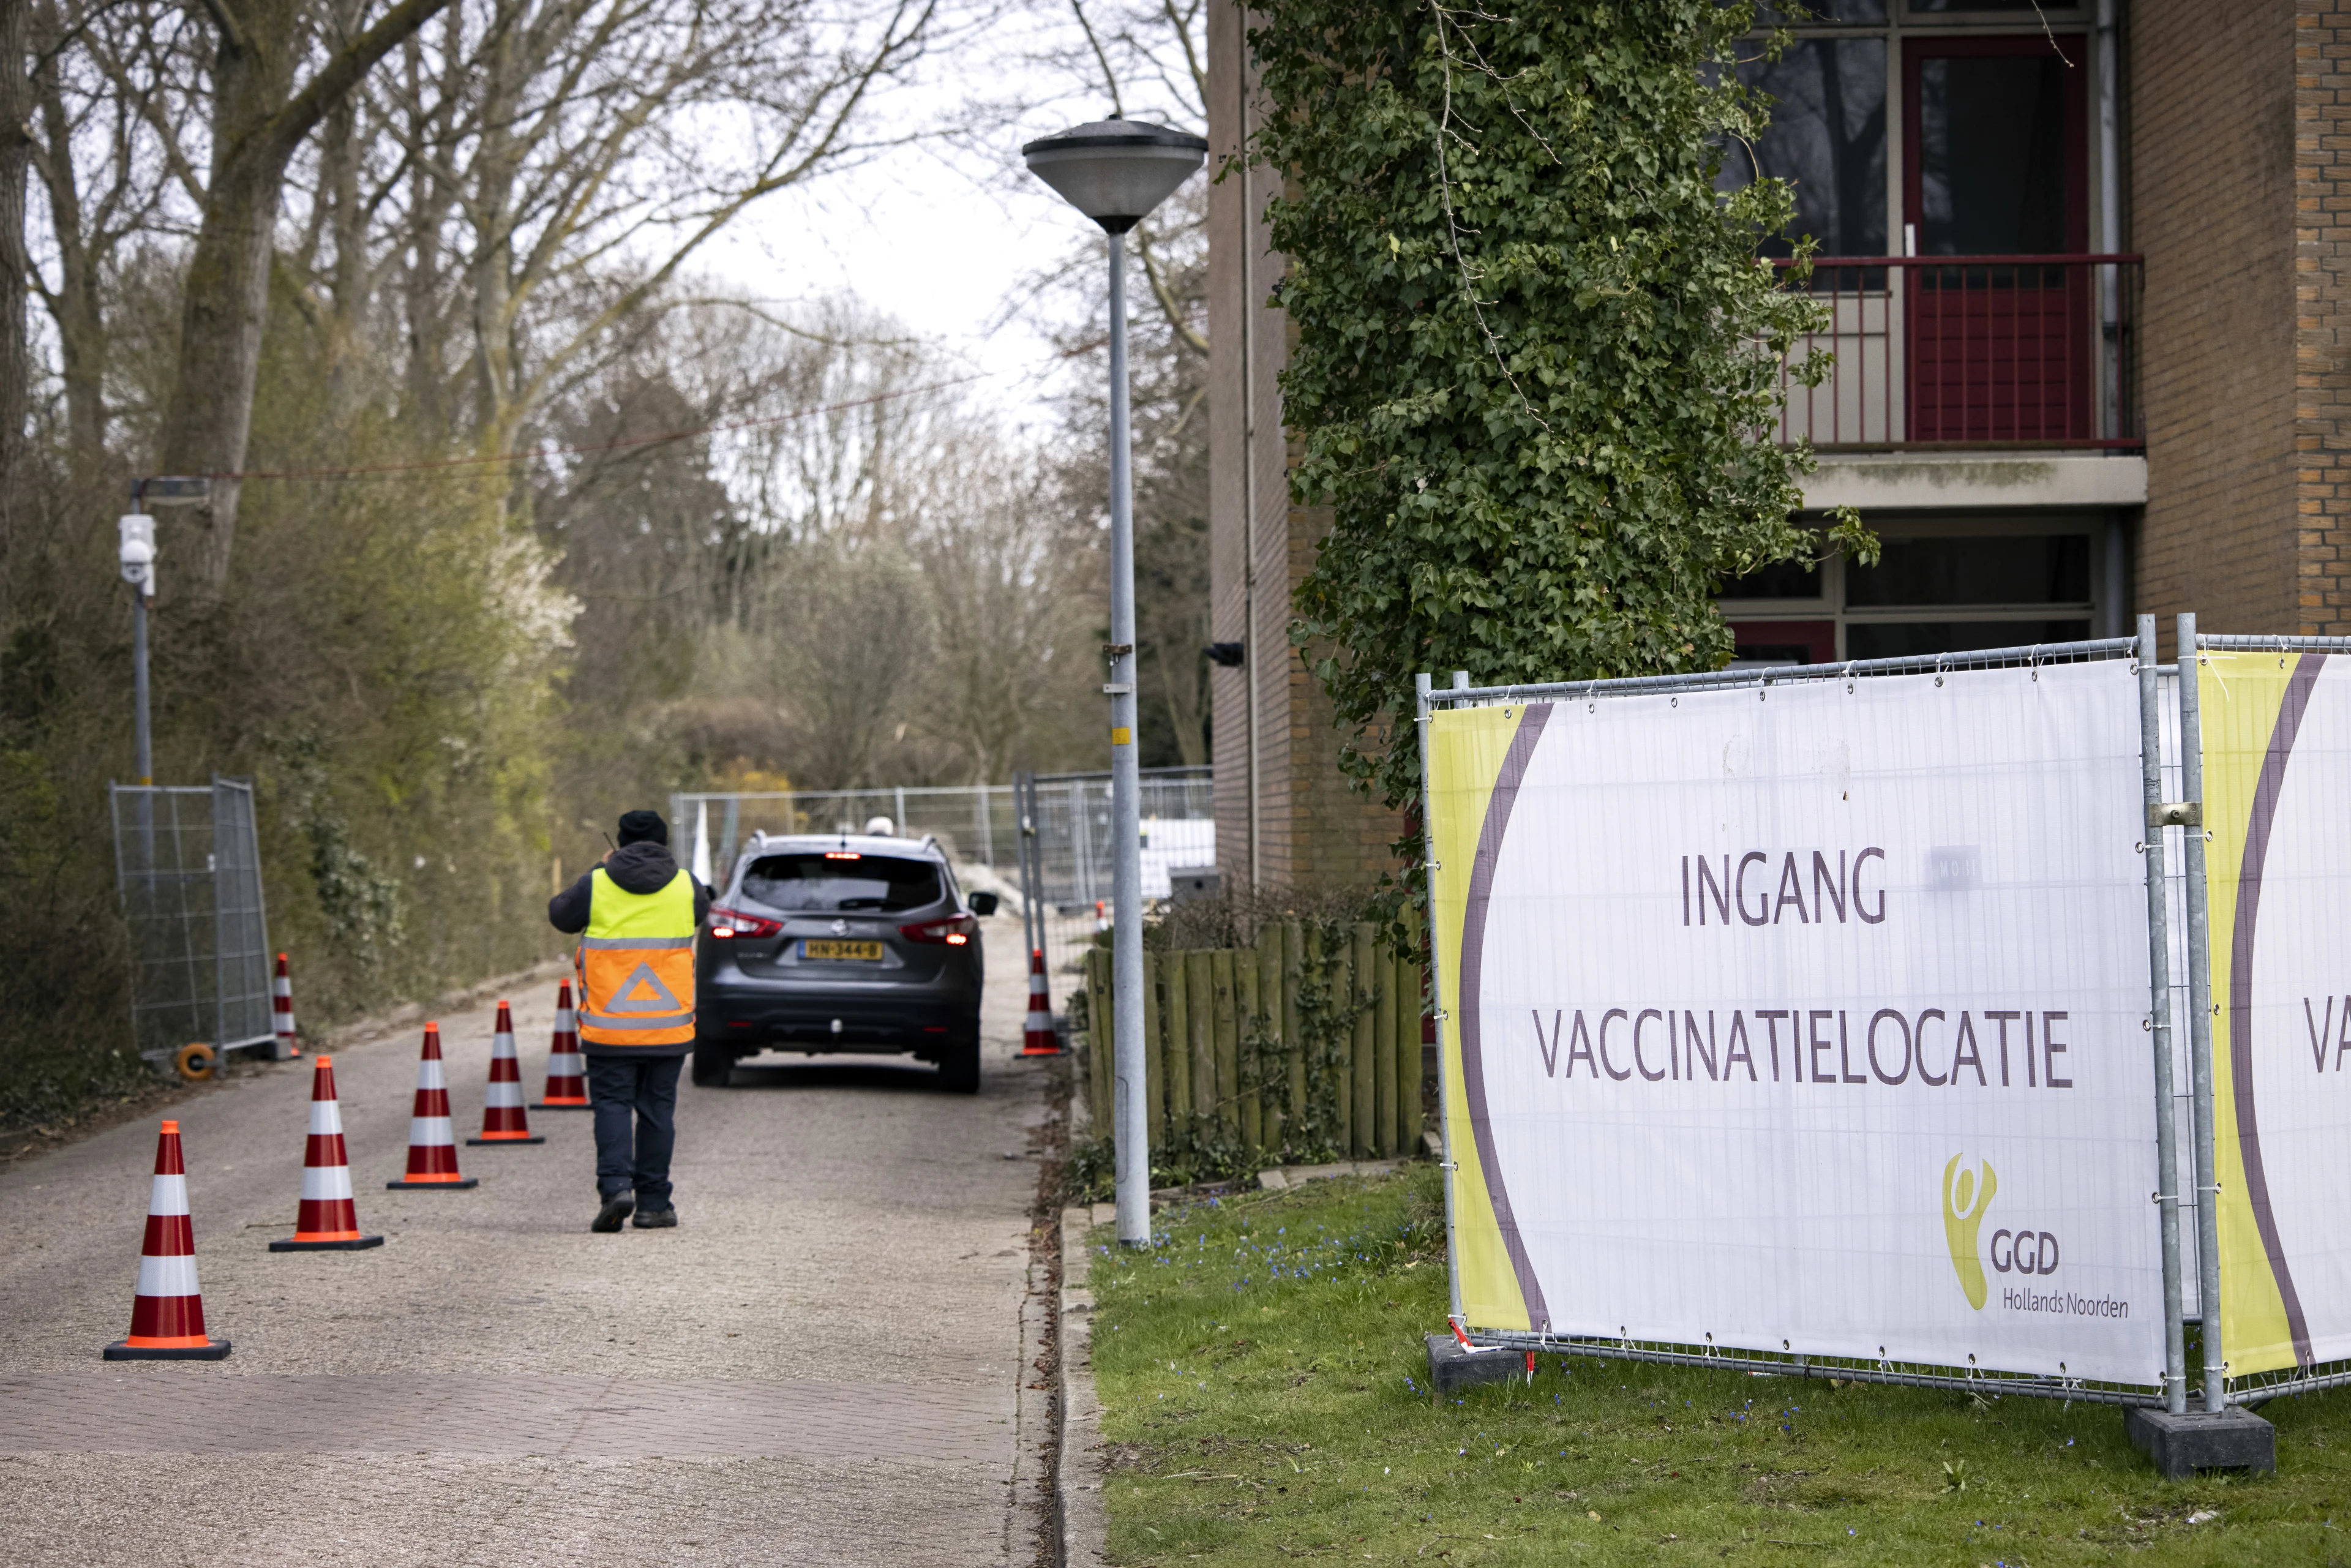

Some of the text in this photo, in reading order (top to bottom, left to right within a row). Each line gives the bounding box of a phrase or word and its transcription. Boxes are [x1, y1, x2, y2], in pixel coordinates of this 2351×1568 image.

[1682, 847, 1886, 926] INGANG
[1532, 1008, 2073, 1088] VACCINATIELOCATIE
[1990, 1229, 2059, 1275] GGD
[2004, 1287, 2128, 1318] Hollands Noorden
